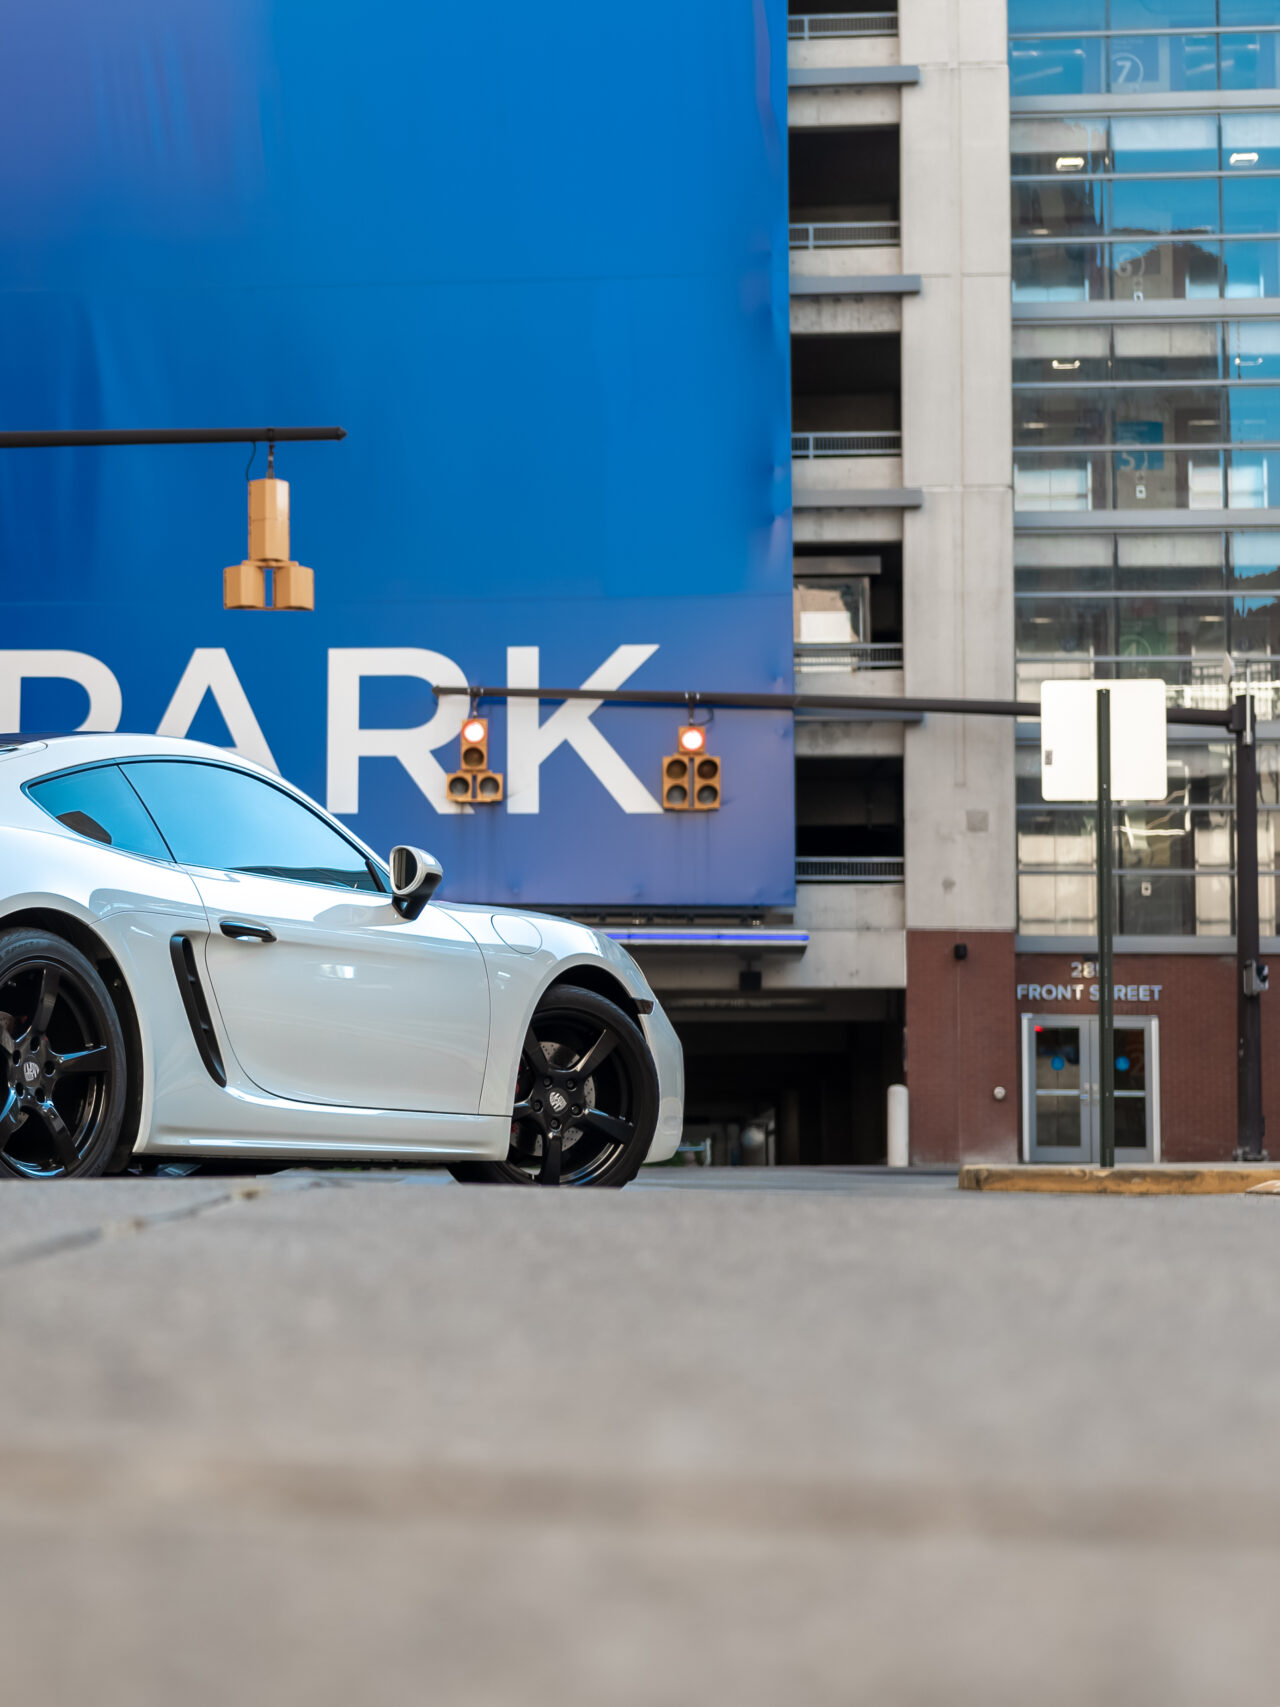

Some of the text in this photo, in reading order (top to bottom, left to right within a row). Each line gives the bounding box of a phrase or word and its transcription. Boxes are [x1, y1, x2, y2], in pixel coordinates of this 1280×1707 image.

[1116, 60, 1131, 84] 7
[1070, 961, 1100, 979] 28
[1016, 983, 1163, 1001] FRONT SREET
